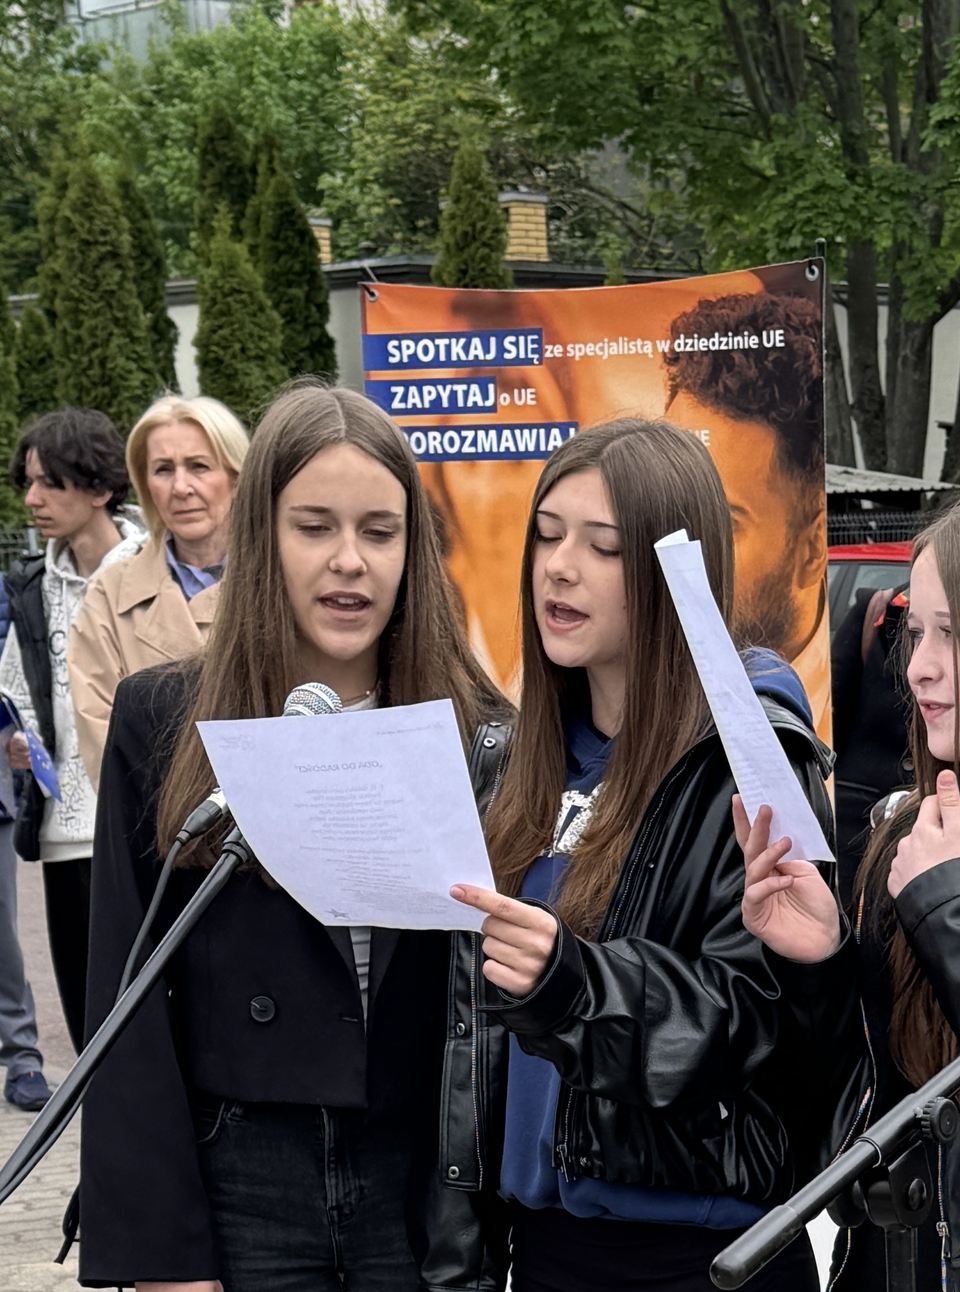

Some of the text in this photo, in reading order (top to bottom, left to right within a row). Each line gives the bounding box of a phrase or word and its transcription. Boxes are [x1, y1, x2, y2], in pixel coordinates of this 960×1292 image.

[386, 329, 786, 365] SPOTKAJ SIĘ ze specjalistą w dziedzinie UE
[389, 382, 537, 409] ZAPYTAJ o UE
[403, 427, 576, 455] OROZMAWIA
